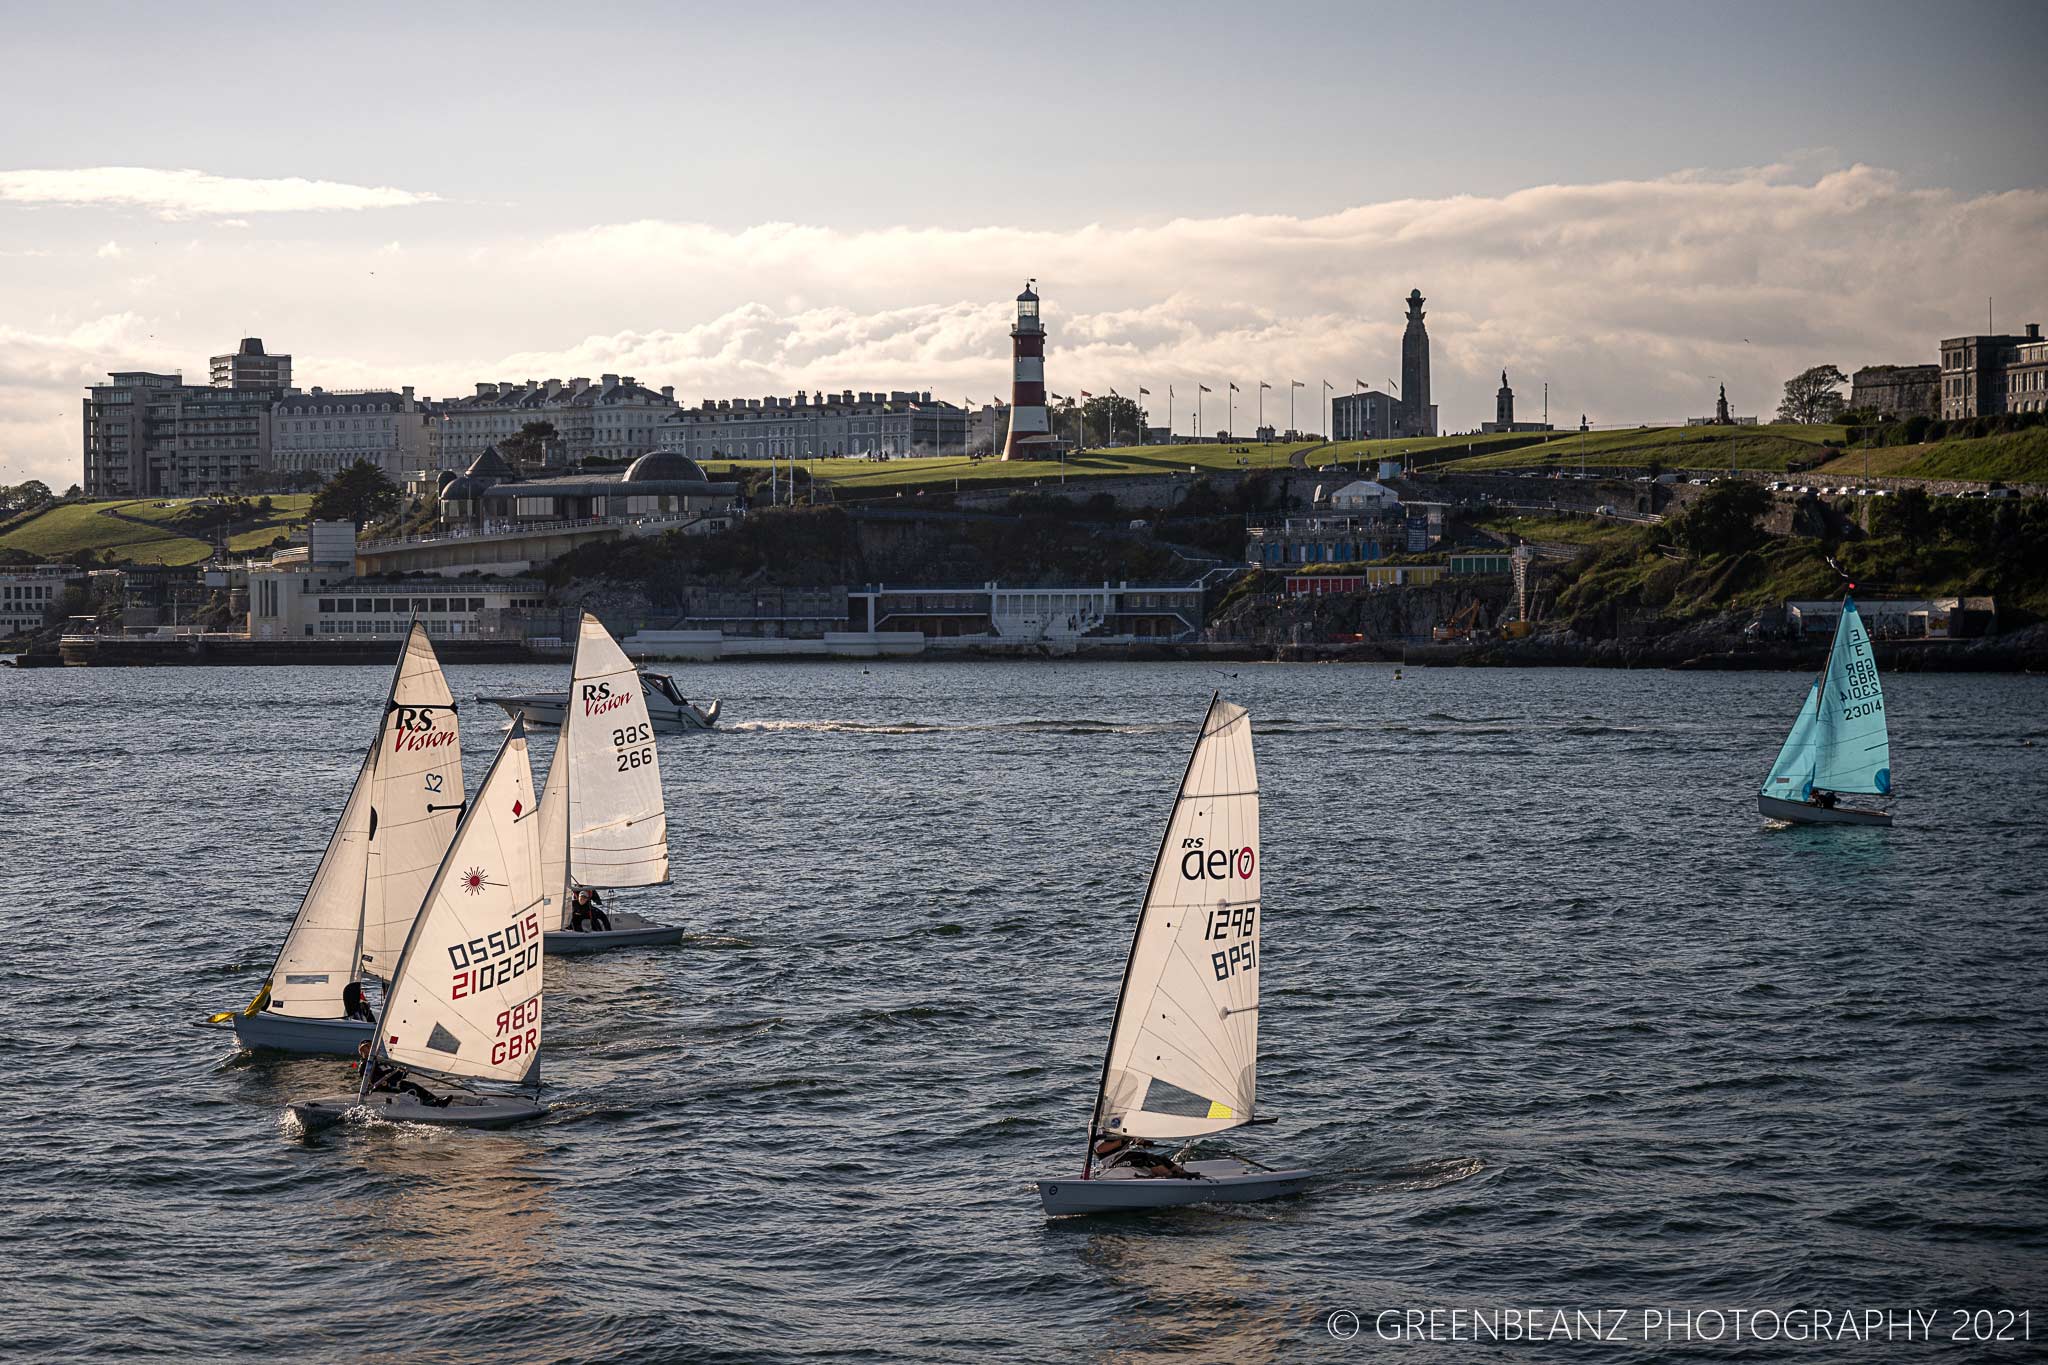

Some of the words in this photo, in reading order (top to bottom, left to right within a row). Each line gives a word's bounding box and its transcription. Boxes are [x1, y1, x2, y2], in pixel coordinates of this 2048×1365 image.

[1855, 644, 1865, 657] E
[1848, 670, 1877, 687] GBR
[582, 682, 610, 701] RS
[584, 691, 633, 718] Vision
[1843, 699, 1882, 721] 23014
[395, 708, 433, 732] RS
[394, 721, 458, 753] Vision
[616, 747, 652, 773] 266
[1181, 837, 1204, 849] RS
[1181, 846, 1255, 880] aero
[1243, 855, 1250, 873] 7
[1204, 907, 1255, 941] 1298
[451, 941, 539, 1001] 210220
[491, 1028, 538, 1066] GBR
